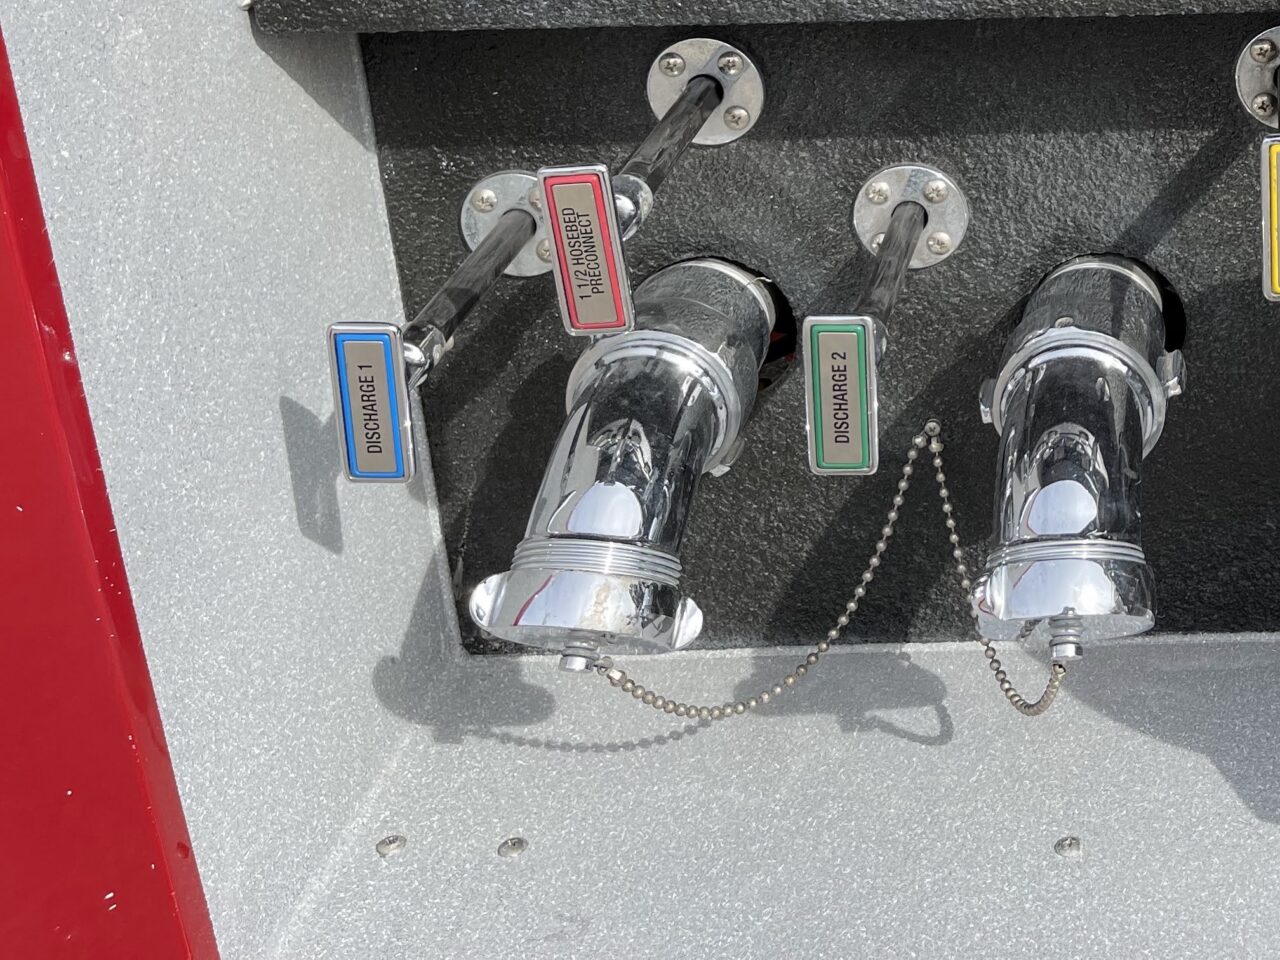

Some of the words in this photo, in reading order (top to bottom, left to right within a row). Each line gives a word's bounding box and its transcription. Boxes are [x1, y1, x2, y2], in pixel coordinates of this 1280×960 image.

[562, 208, 585, 265] HOSEBED
[576, 212, 604, 294] PRECONNECT
[575, 270, 589, 289] 1/2
[832, 352, 846, 360] 2
[358, 375, 382, 454] DISCHARGE
[832, 365, 849, 443] DISCHARGE
